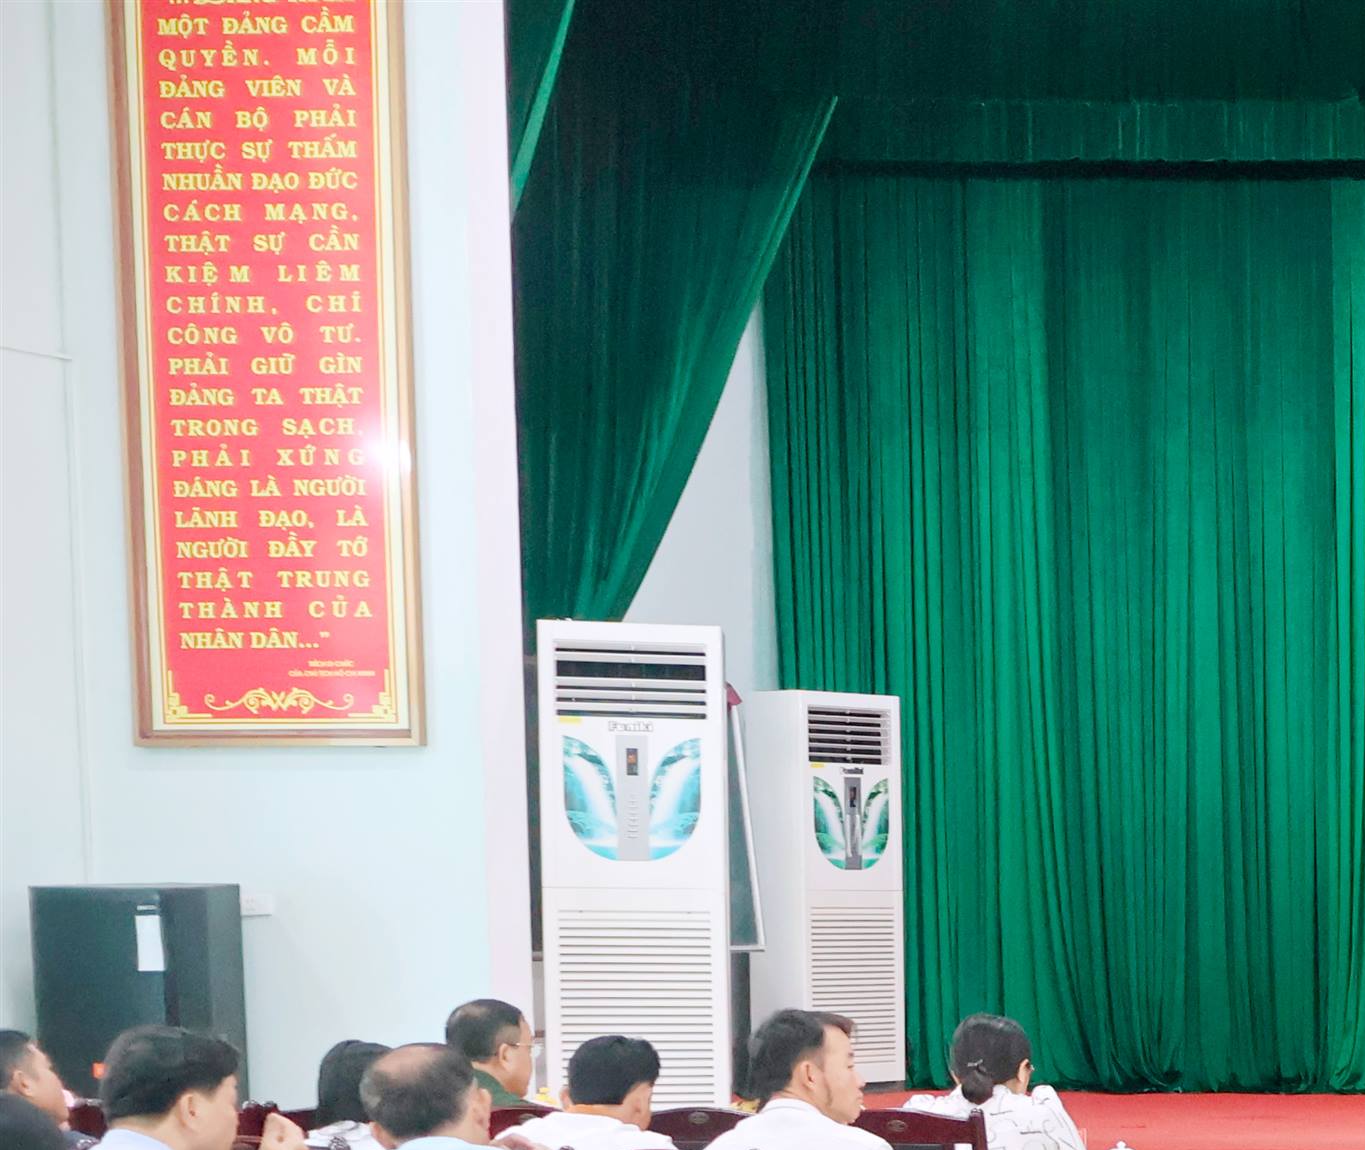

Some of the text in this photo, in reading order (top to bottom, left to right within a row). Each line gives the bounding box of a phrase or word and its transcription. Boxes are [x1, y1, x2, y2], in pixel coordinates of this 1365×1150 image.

[158, 7, 355, 38] MỘT ĐẢNG CẦM
[297, 39, 356, 65] MỖI
[159, 74, 356, 98] ĐẢNG VIÊN VÀ
[160, 104, 357, 131] CÁN BỘ PHẢI
[161, 133, 358, 162] THỰC SỰ THẤM
[162, 164, 357, 193] NHUẦN ĐẠO ĐỨC
[164, 200, 242, 221] CÁCH
[164, 225, 359, 255] THẬT SỰ CẦN
[166, 260, 360, 286] KIỆM LIÊM
[168, 323, 238, 345] CÔNG
[261, 322, 294, 344] VÔ
[169, 352, 362, 375] PHẢI GIỮ GÌN
[170, 383, 363, 407] ĐẢNG TA THẬT
[171, 419, 259, 436] TRONG
[173, 444, 366, 467] PHẢI XỨNG
[250, 475, 281, 497] LÀ
[294, 475, 366, 496] NGƯỜI
[175, 505, 368, 530] LÃNH ĐẠO, LÀ
[176, 537, 248, 558] NGƯỜI
[268, 532, 317, 557] ĐẦY
[177, 567, 370, 592] THẬT TRUNG
[179, 595, 372, 618] THÀNH CỦA
[180, 628, 244, 649] NHÂN
